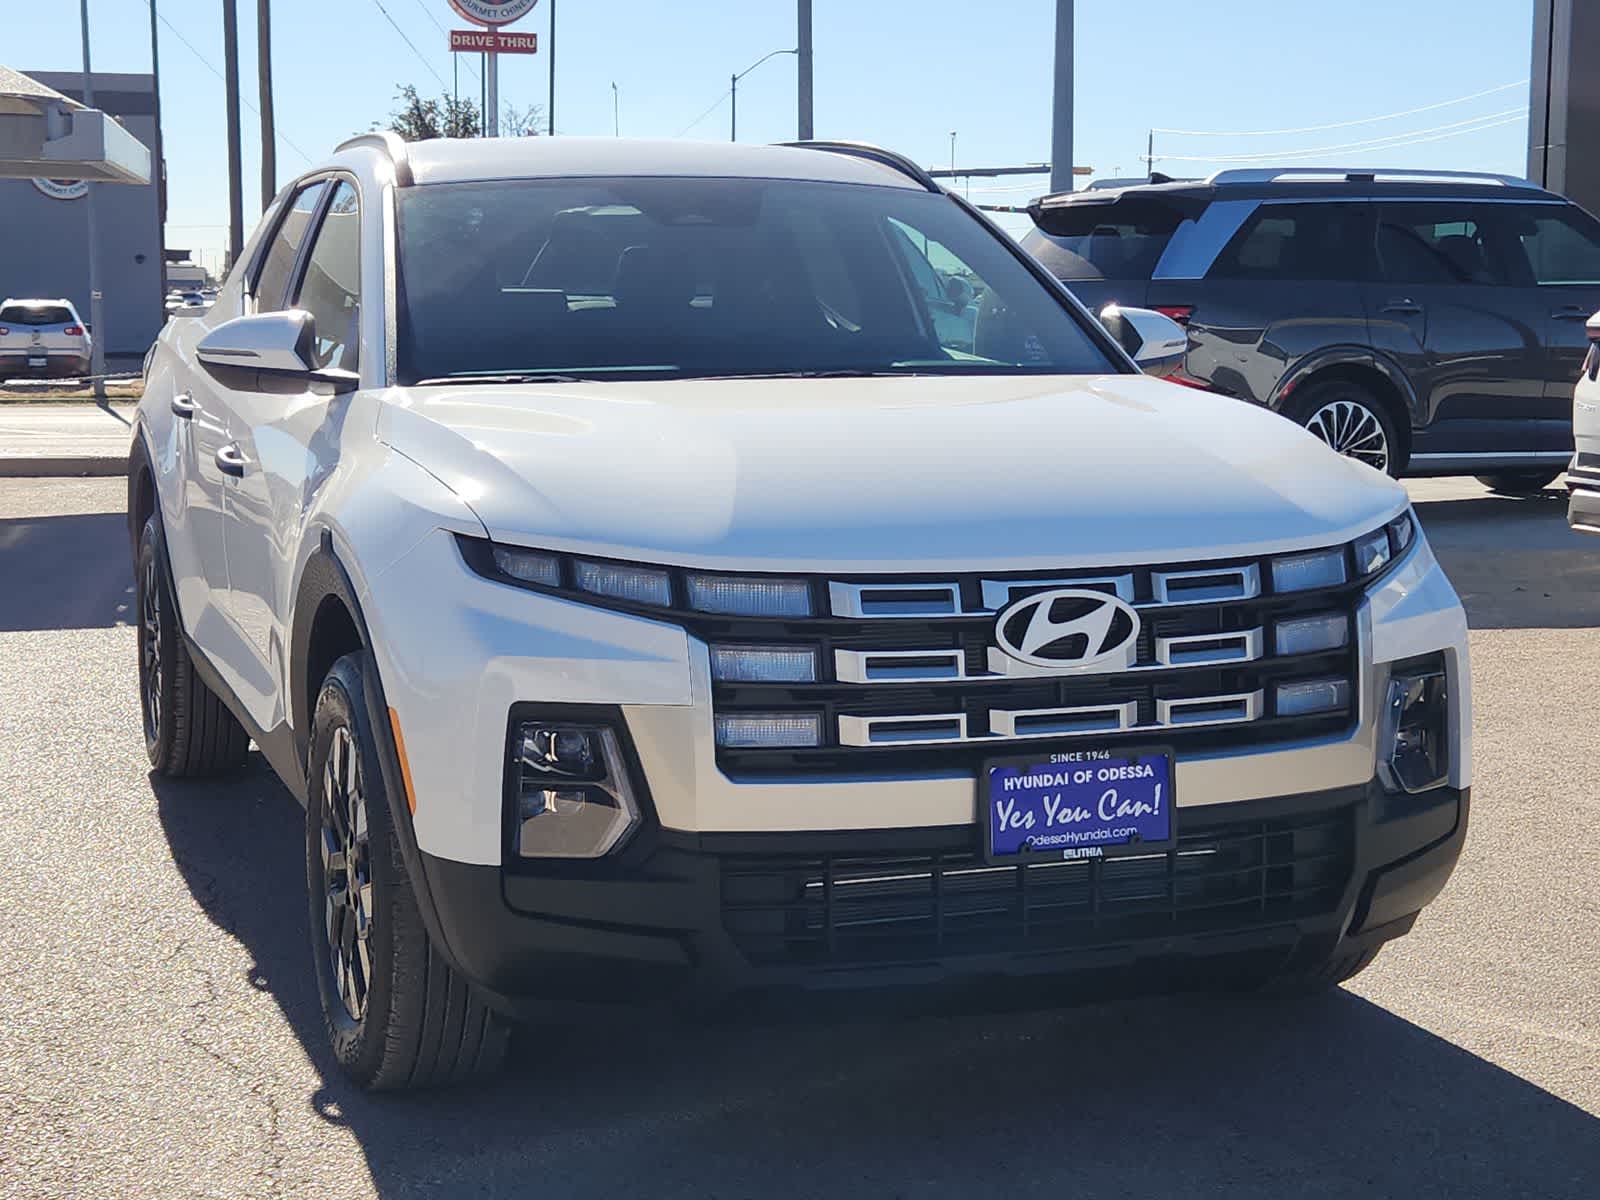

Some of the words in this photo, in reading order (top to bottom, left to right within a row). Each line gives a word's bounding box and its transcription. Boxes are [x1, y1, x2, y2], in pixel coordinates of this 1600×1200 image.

[452, 35, 495, 47] DRIVE
[497, 36, 536, 49] THRU
[1050, 752, 1083, 764] SINCE
[1085, 749, 1110, 761] 1946
[1004, 772, 1069, 791] HYUNDAI
[1073, 770, 1093, 784] OF
[1097, 764, 1154, 781] ODESSA
[996, 798, 1036, 831] Yes
[1043, 793, 1092, 827] You
[1098, 783, 1162, 821] Can!
[1026, 827, 1138, 846] OdessaHyundai.com
